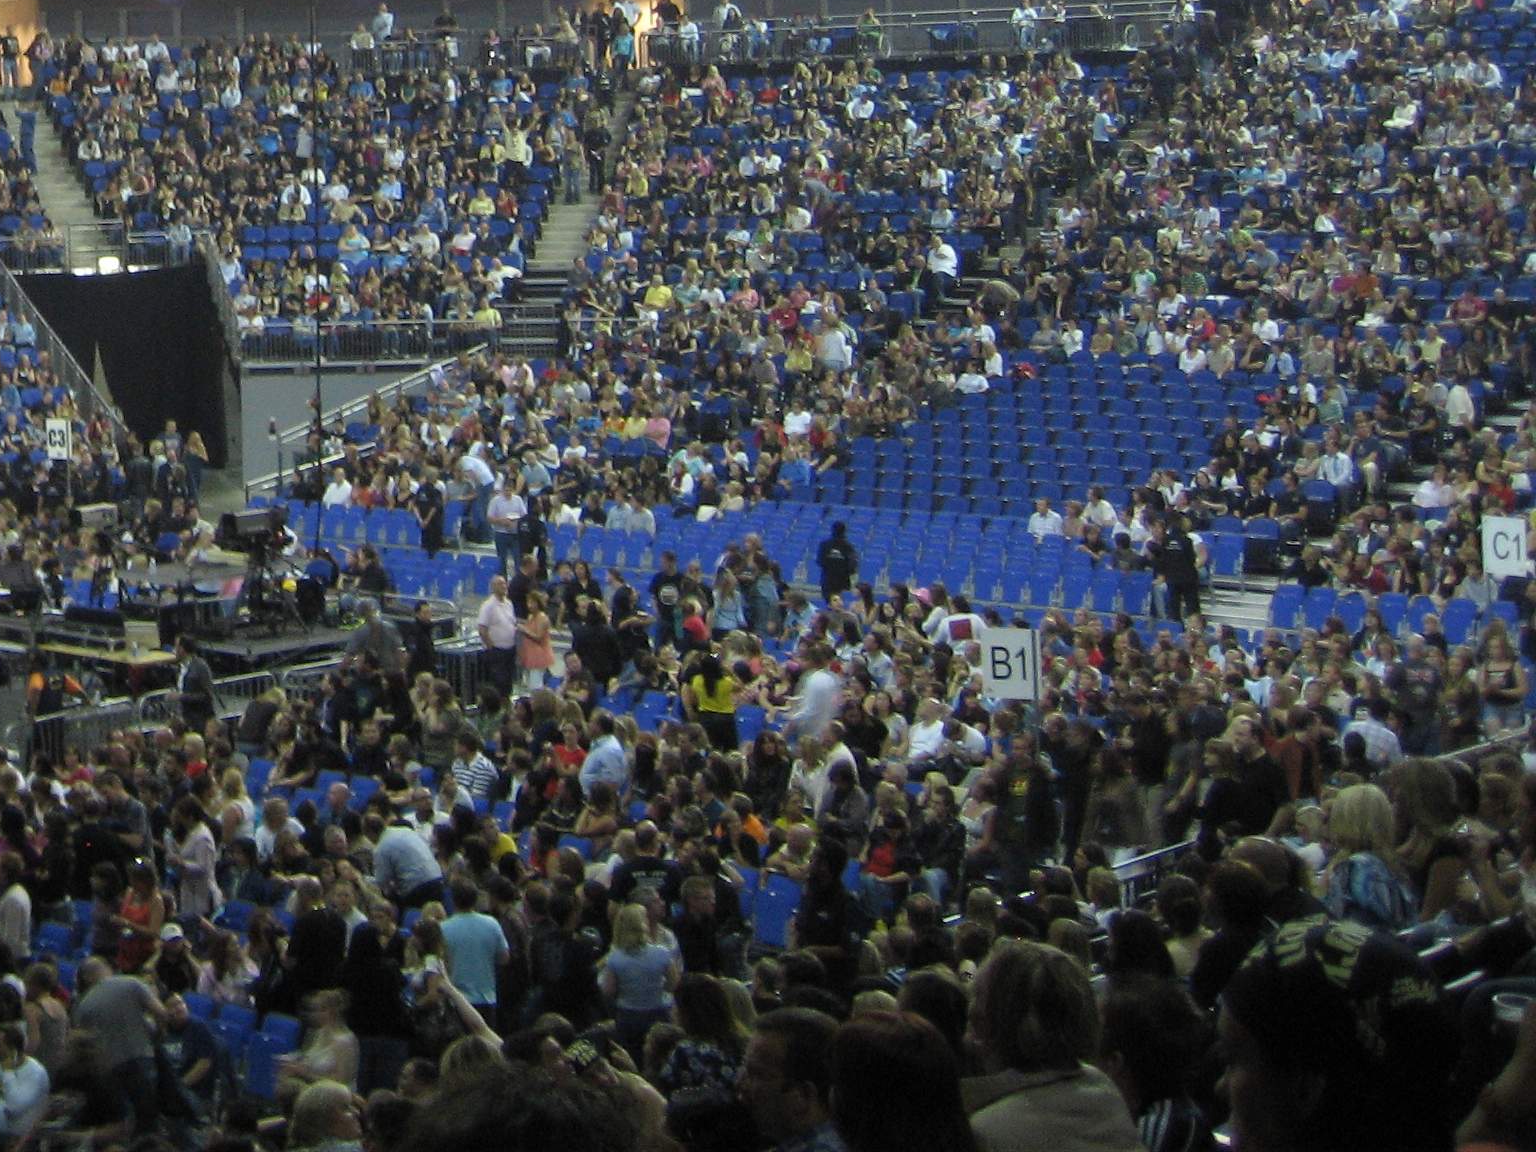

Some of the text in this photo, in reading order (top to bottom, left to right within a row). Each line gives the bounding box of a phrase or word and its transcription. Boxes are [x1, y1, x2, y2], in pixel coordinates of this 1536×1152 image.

[49, 429, 65, 447] C3
[1493, 531, 1521, 561] C1
[991, 646, 1027, 681] B1
